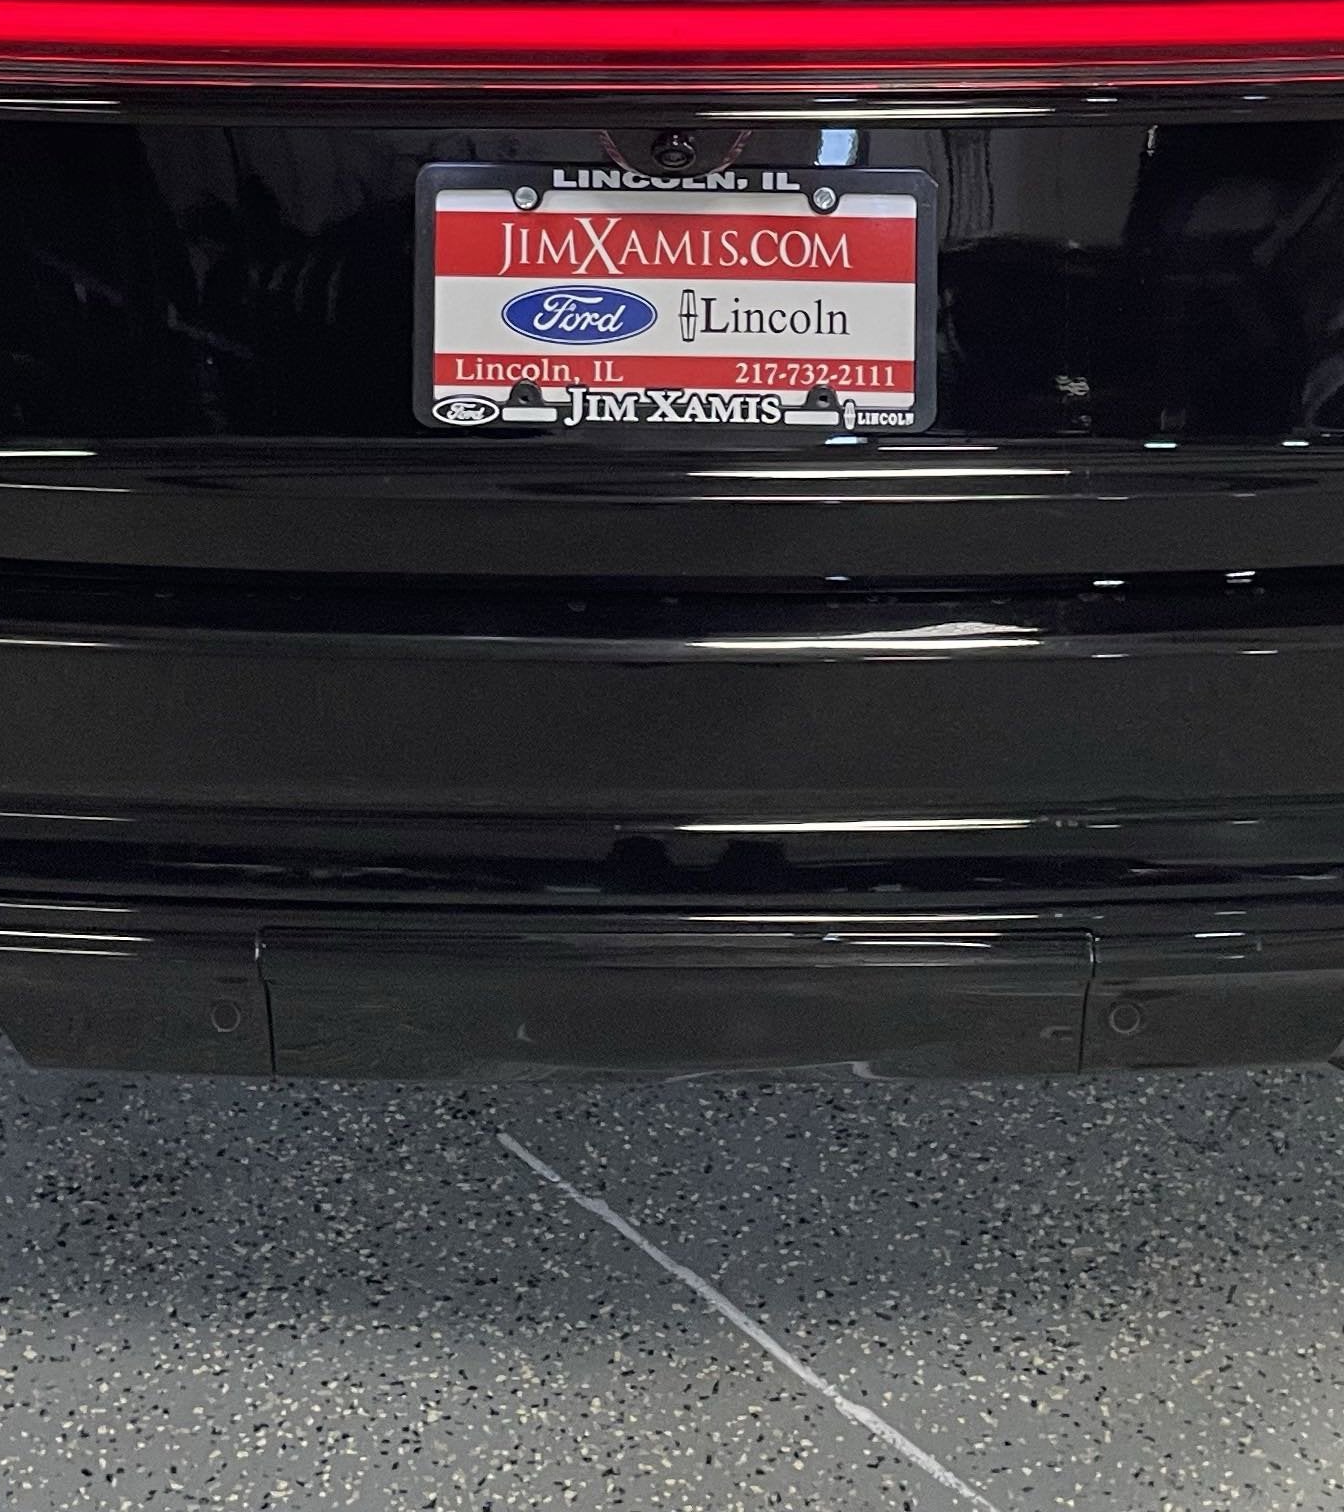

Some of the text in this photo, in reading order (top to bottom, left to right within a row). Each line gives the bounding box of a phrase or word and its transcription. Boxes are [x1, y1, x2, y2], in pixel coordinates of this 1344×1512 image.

[762, 171, 801, 191] IL
[497, 216, 854, 276] JIMXAMIS.COM
[700, 297, 850, 335] Lincoln
[455, 357, 624, 385] Lincoln, IL
[735, 362, 896, 387] 217-732-2111
[563, 387, 782, 427] JIM XAMIS
[857, 412, 915, 426] LINCOLN
